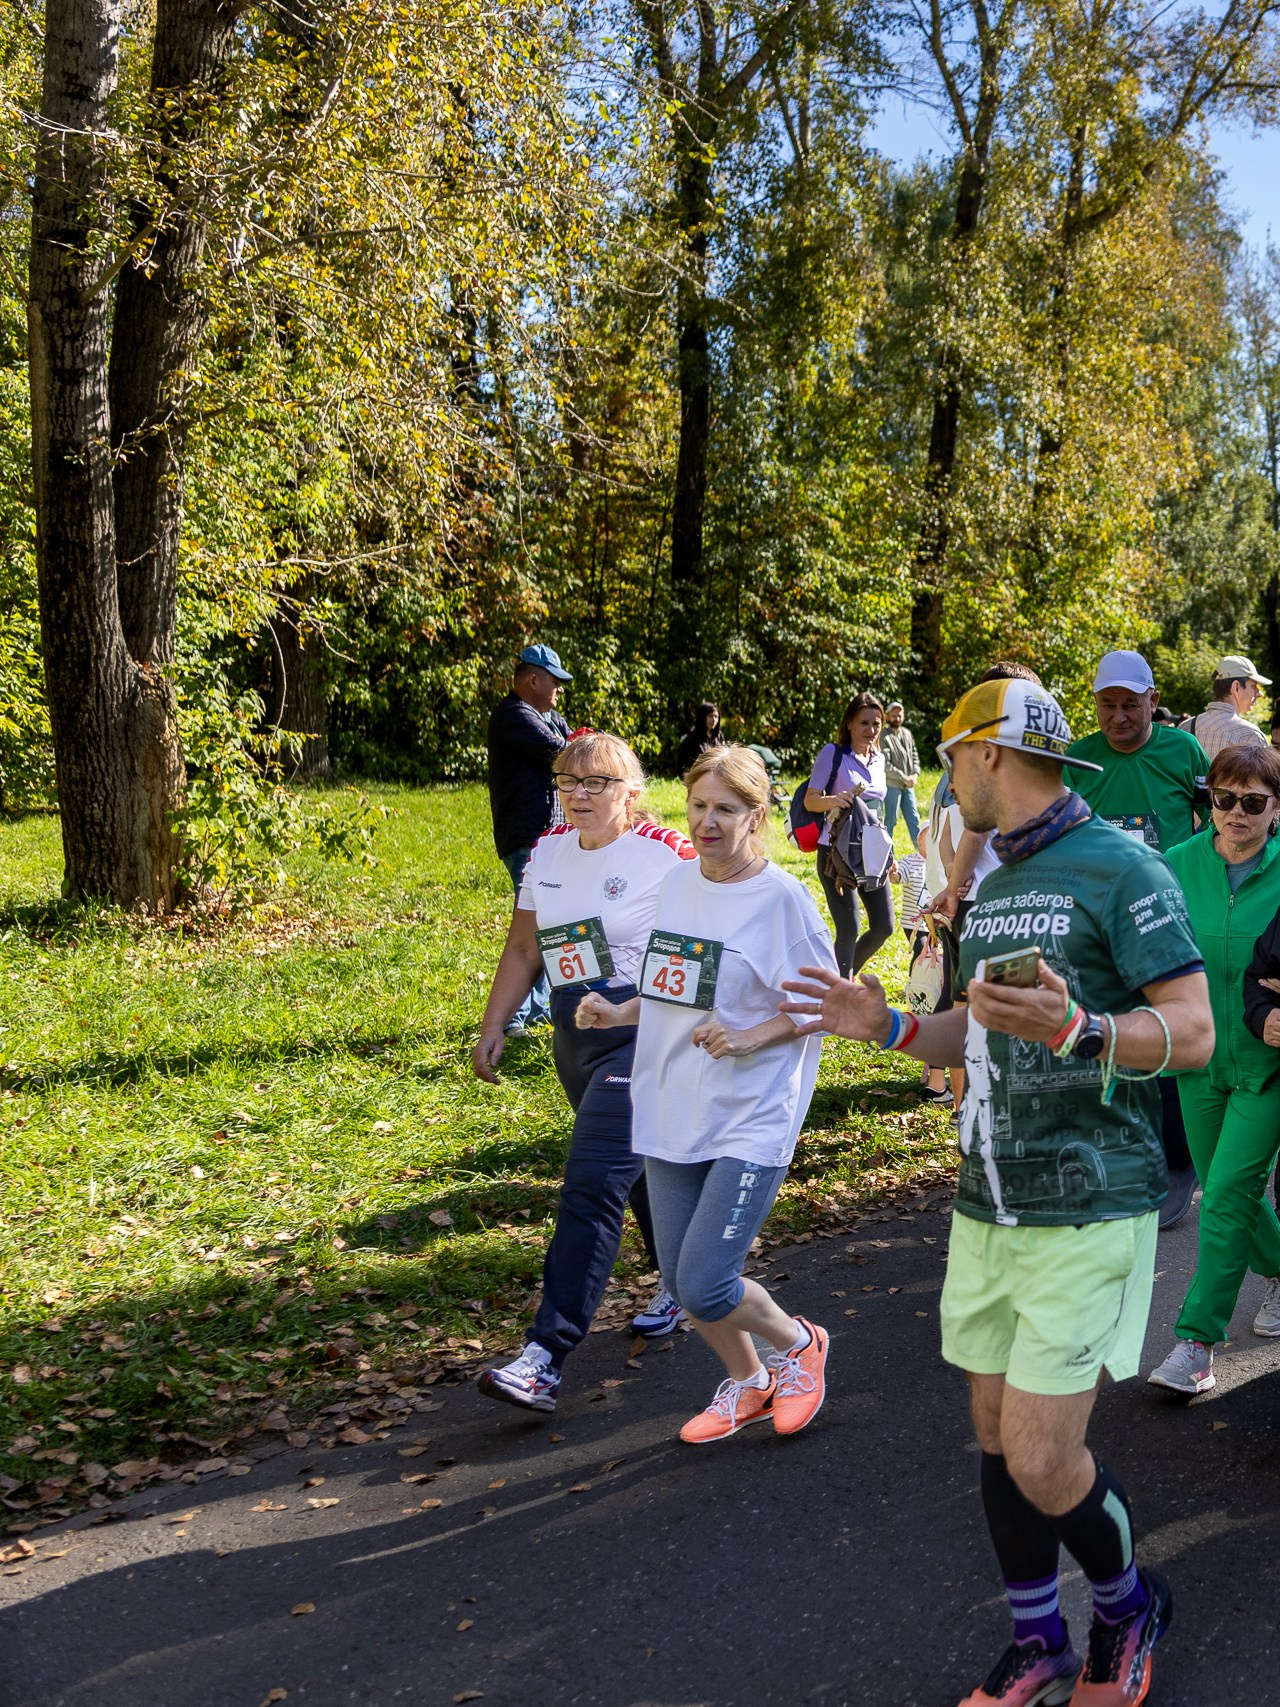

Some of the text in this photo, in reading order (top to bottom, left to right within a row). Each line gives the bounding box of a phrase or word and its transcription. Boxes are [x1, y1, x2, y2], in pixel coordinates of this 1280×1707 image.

[1024, 732, 1047, 749] THE
[979, 890, 1075, 915] серия забегов
[1128, 892, 1159, 913] спорт
[1134, 908, 1154, 926] для
[1138, 914, 1173, 936] жизни
[559, 953, 587, 980] 61
[652, 966, 686, 997] 43
